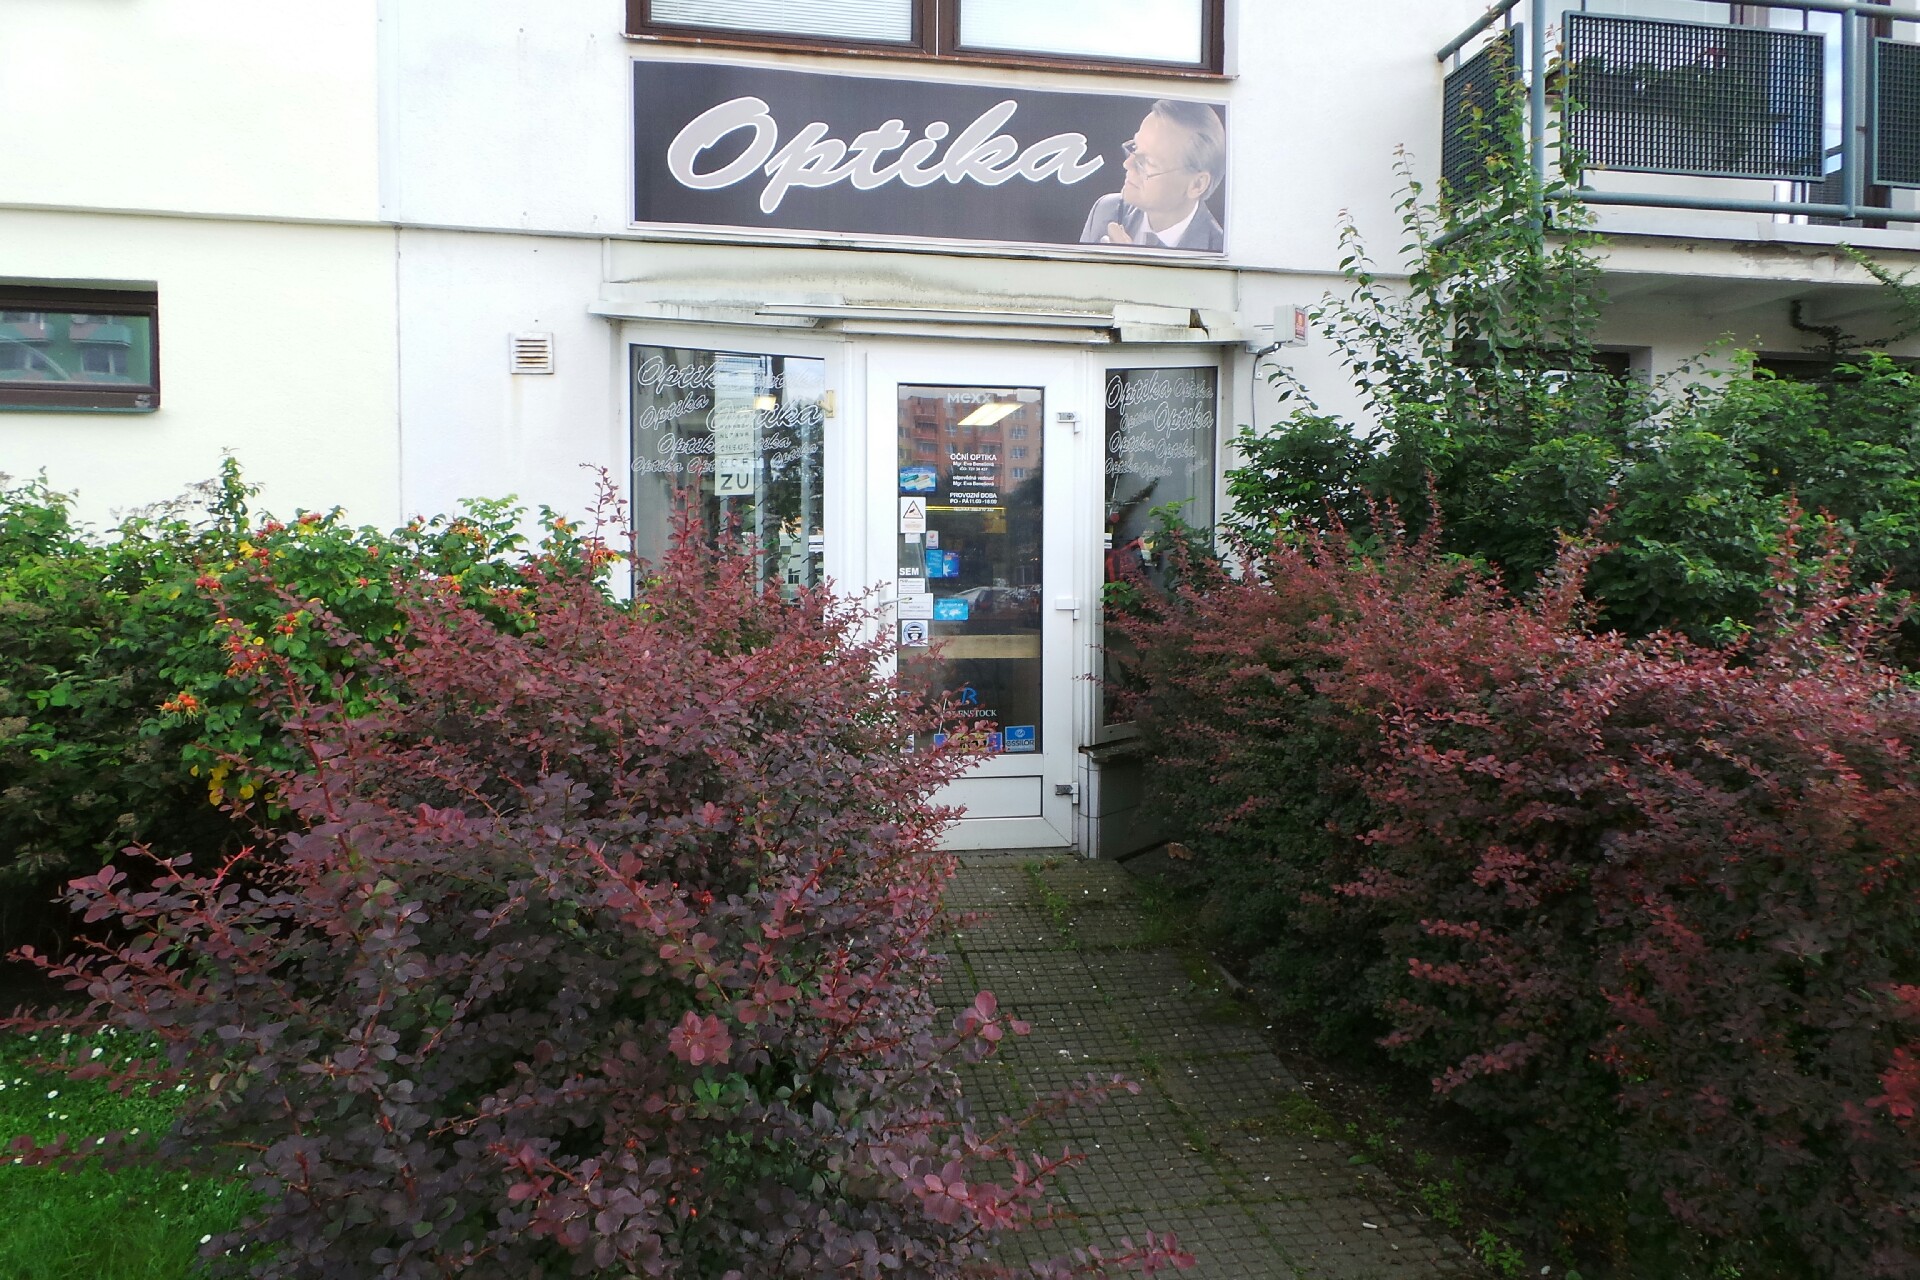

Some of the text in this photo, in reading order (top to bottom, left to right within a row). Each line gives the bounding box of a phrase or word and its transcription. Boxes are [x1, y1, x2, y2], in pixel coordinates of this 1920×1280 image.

[667, 96, 1104, 214] Optika
[638, 356, 722, 394] Optik
[1106, 370, 1172, 415] Optika
[1174, 377, 1214, 403] Optika
[640, 391, 709, 430] Optika
[1154, 401, 1214, 438] Optika
[950, 453, 969, 461] OČNÍ
[1109, 431, 1155, 458] Optika
[1155, 438, 1197, 465] Optika
[631, 456, 683, 475] Optika
[899, 567, 920, 576] SEM
